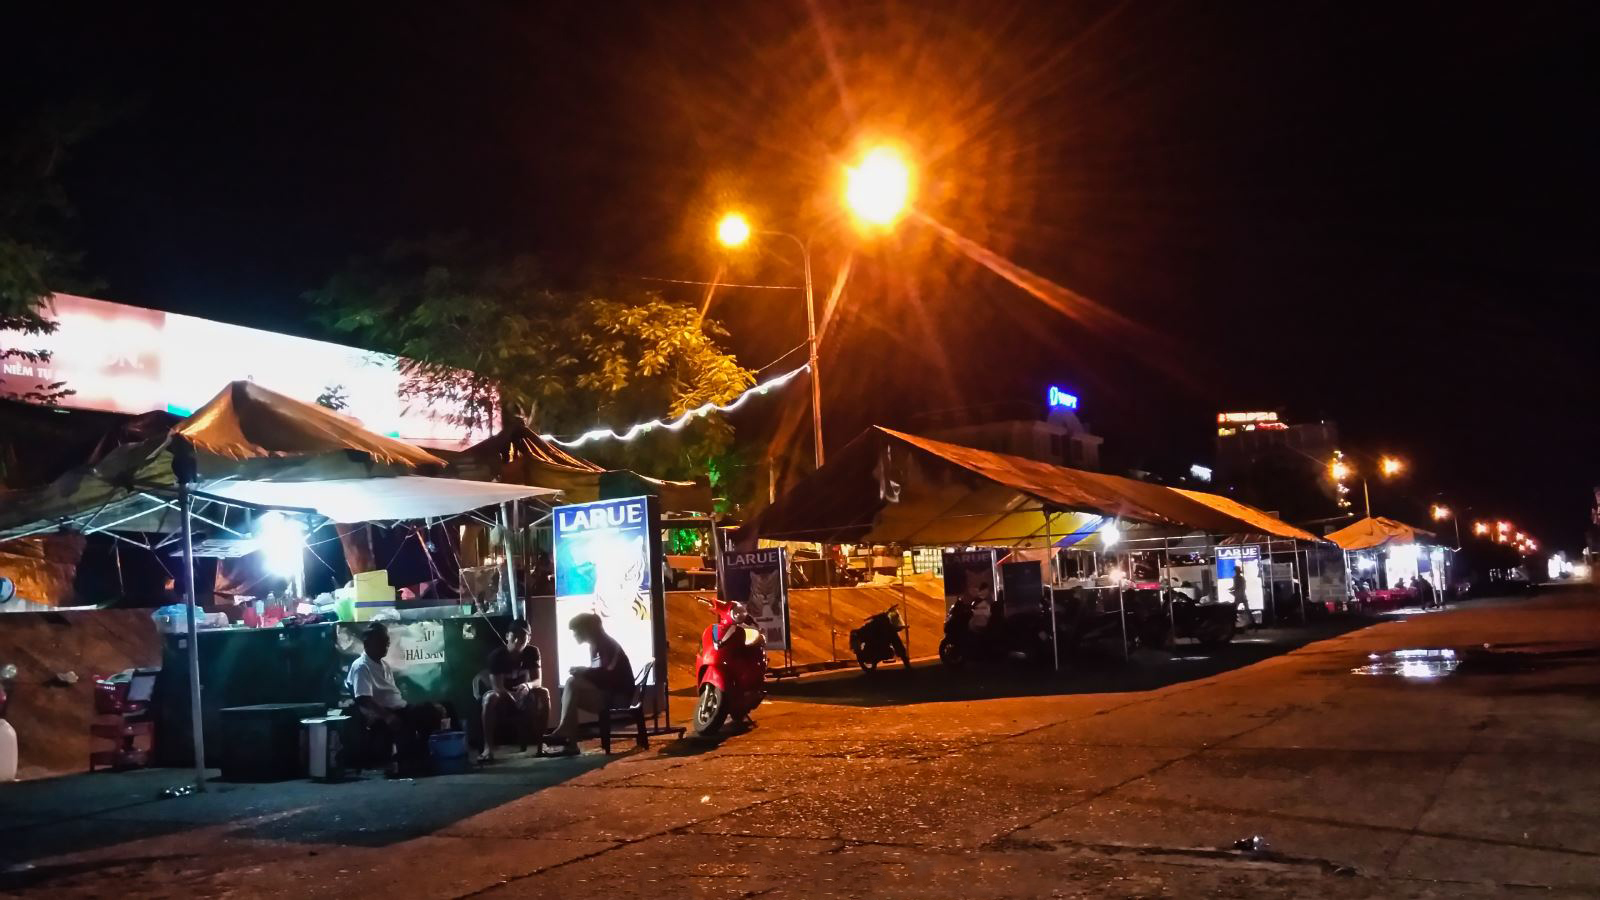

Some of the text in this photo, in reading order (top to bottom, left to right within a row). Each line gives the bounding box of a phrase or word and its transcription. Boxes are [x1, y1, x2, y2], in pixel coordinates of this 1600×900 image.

[559, 503, 642, 532] LARUE
[726, 551, 778, 566] LARUE
[1218, 548, 1258, 557] LARUE
